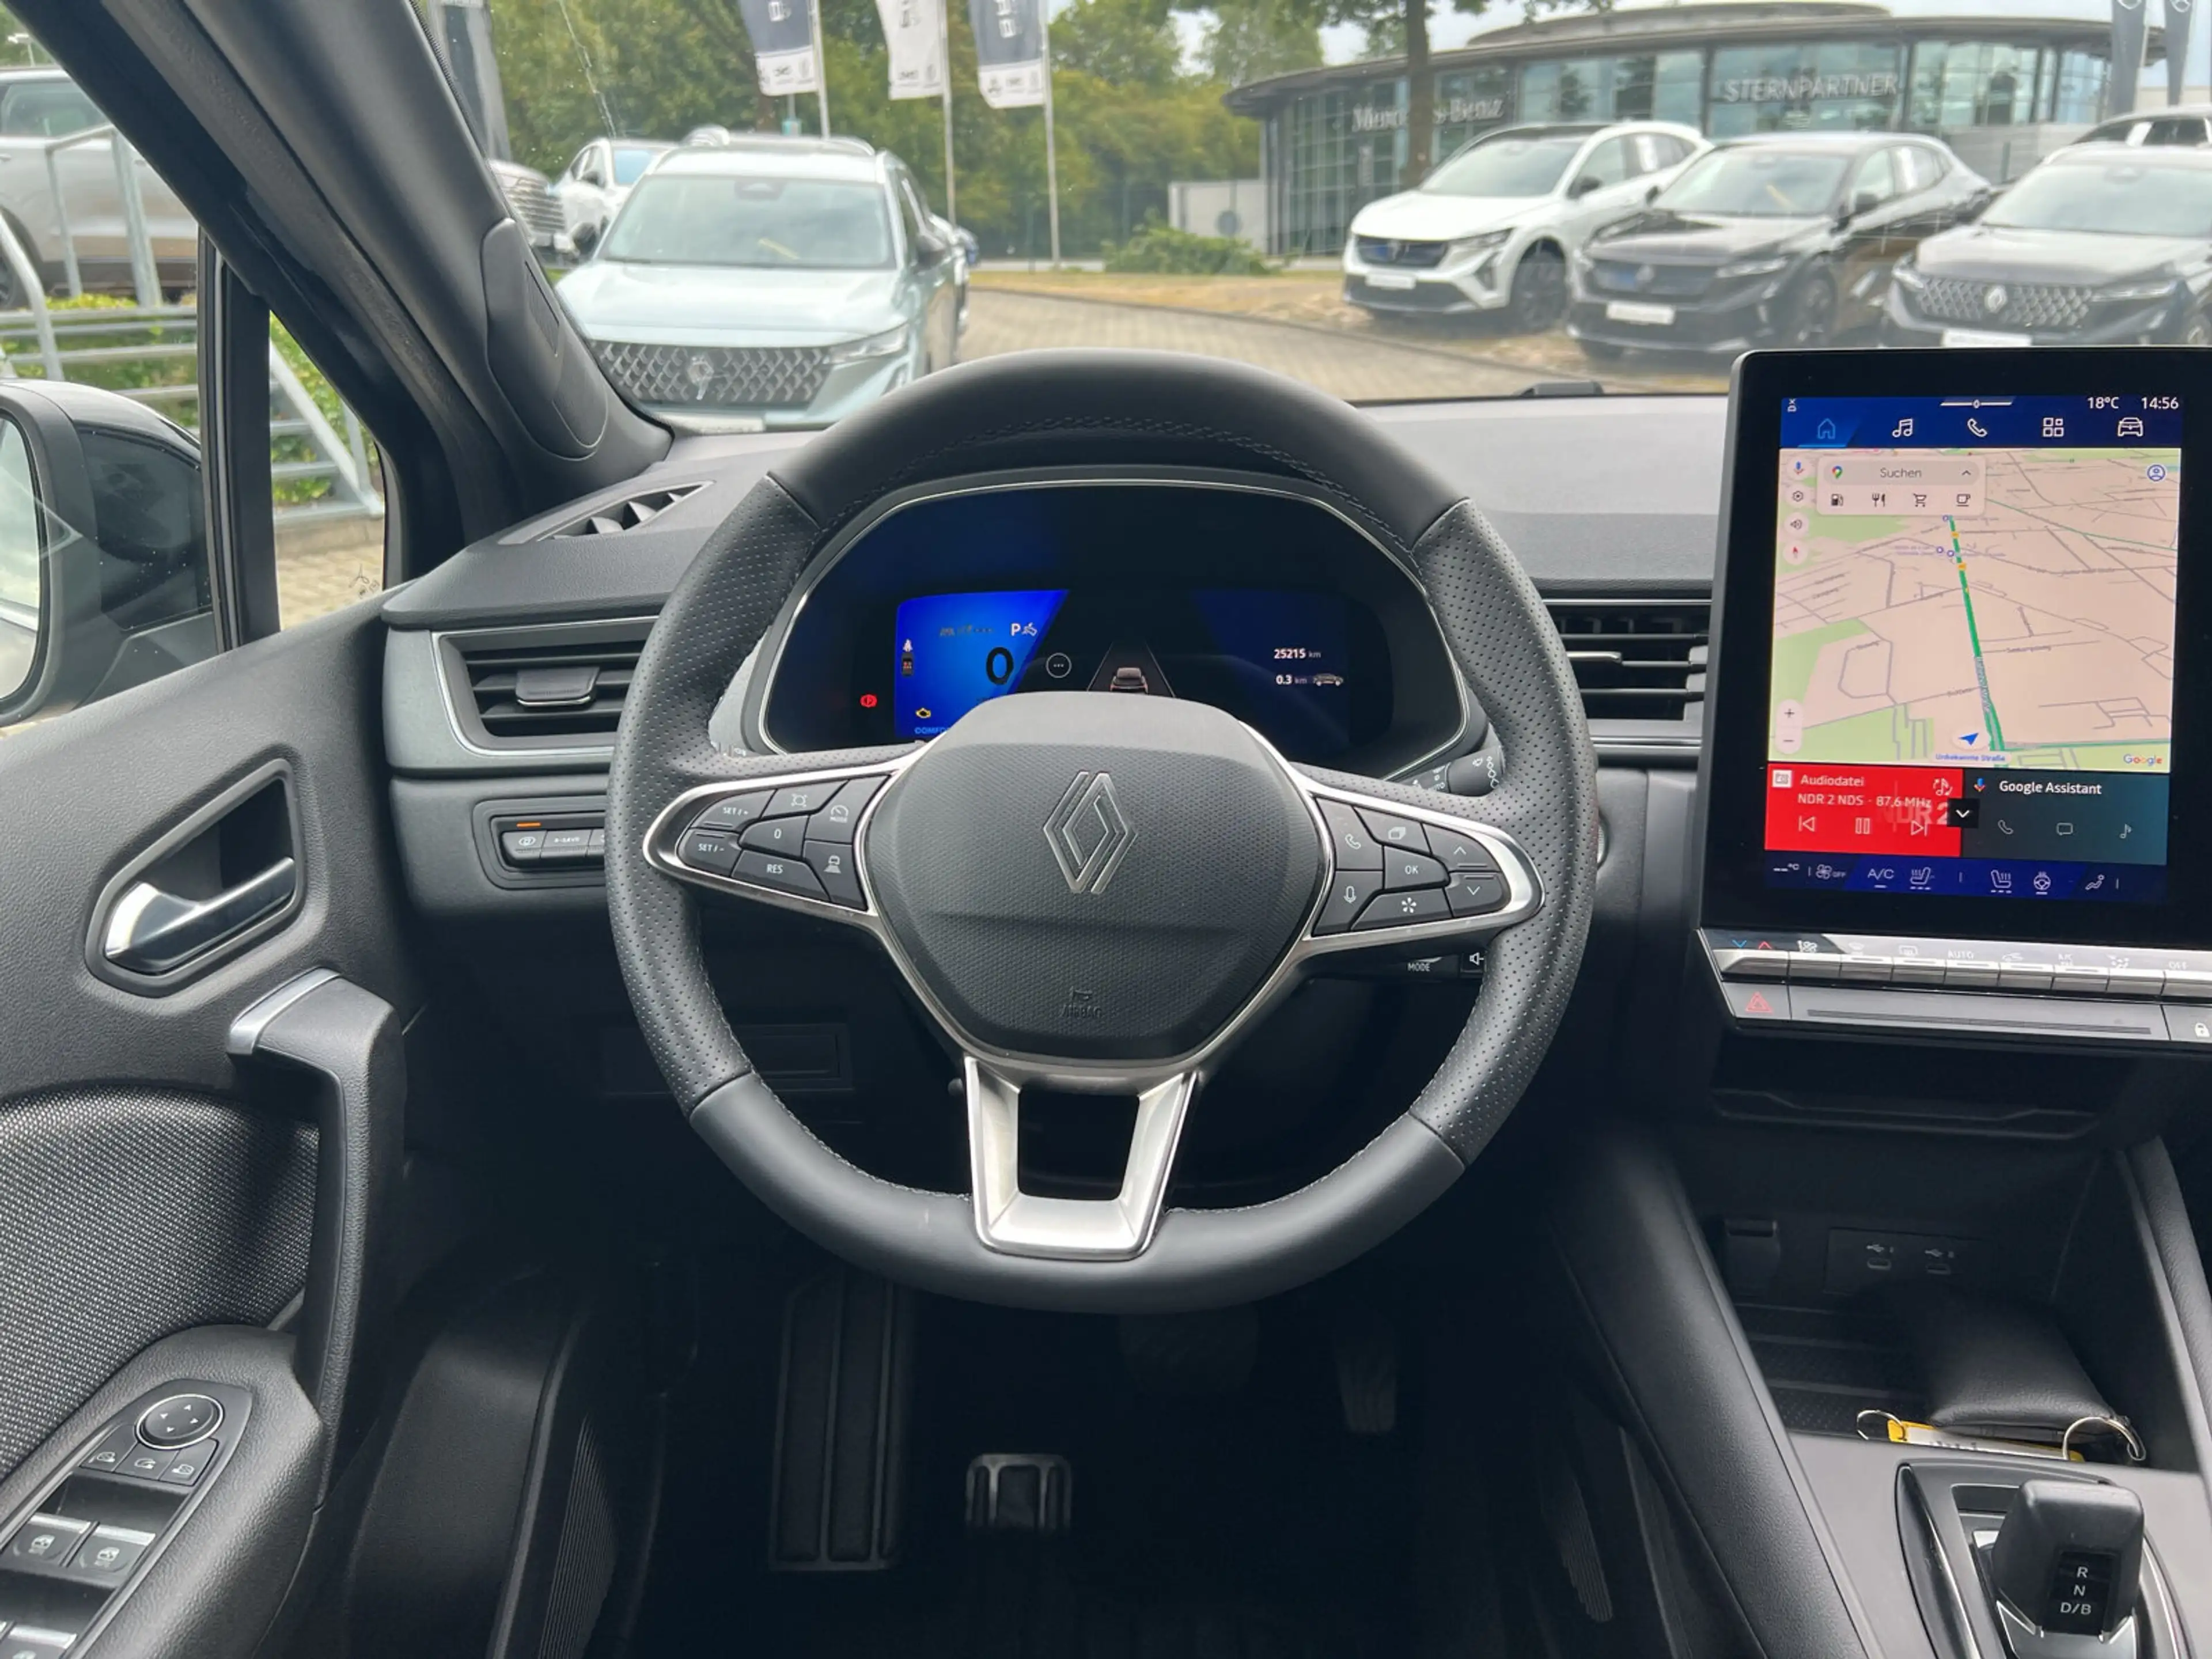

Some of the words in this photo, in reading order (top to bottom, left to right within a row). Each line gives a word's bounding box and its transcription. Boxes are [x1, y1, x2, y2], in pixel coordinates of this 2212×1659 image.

[1724, 71, 1897, 102] STERNPARTNER
[2088, 396, 2119, 410] 18°C
[2141, 397, 2179, 410] 14:56
[1880, 467, 1922, 479] Suchen
[1011, 623, 1021, 637] P
[1274, 647, 1306, 660] 25215
[986, 646, 1014, 685] 0
[1275, 674, 1293, 685] 0.3
[914, 726, 952, 734] COMFO
[2123, 753, 2163, 767] Google
[1800, 774, 1865, 787] Audiodatei
[1999, 781, 2043, 795] Google
[2045, 782, 2102, 795] Assistant
[1797, 793, 1824, 805] NDR
[1827, 794, 1836, 805] 2
[1838, 794, 1864, 806] NDS
[1904, 797, 1932, 808] MHz
[766, 863, 783, 874] RES
[1404, 865, 1419, 875] OK
[1867, 868, 1895, 880] A/C
[1948, 949, 1975, 959] AUTO
[1407, 962, 1431, 972] MODE
[2077, 1566, 2089, 1578] R
[2073, 1584, 2086, 1597] N
[2060, 1601, 2092, 1615] D/B
